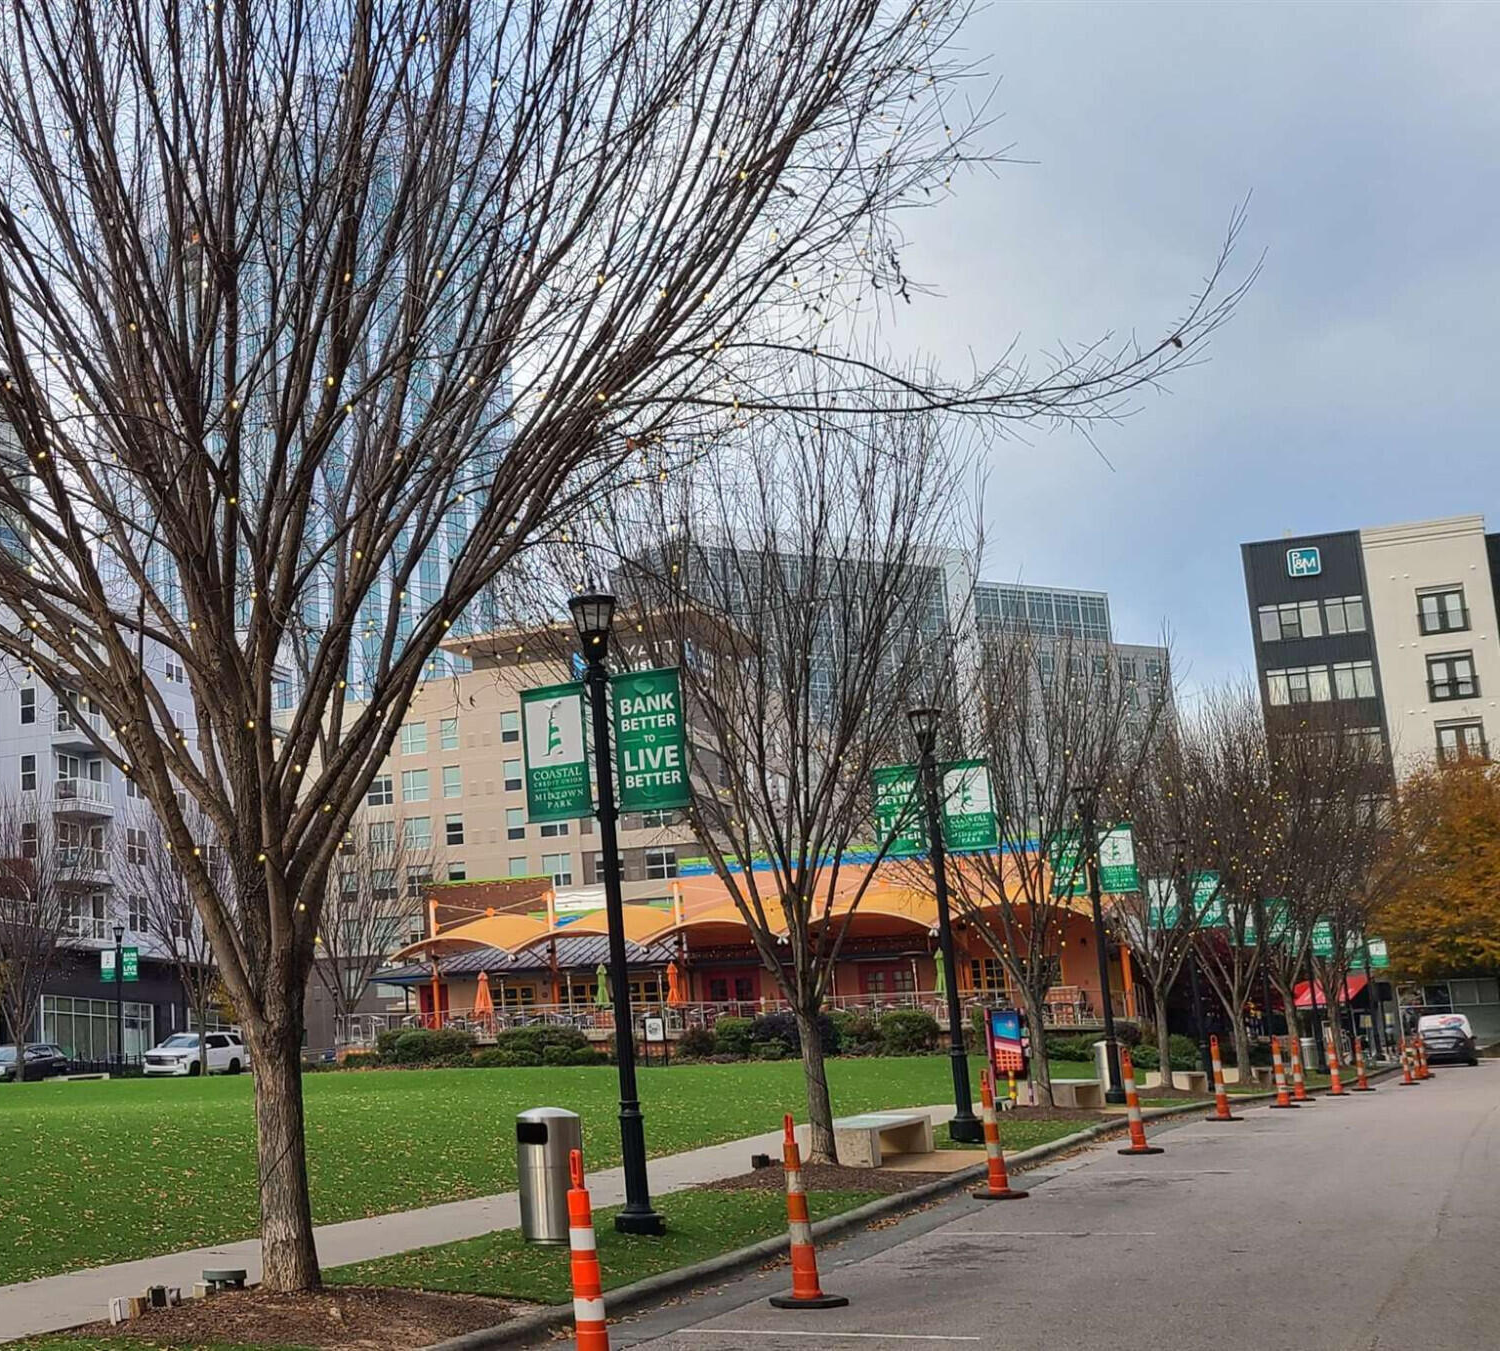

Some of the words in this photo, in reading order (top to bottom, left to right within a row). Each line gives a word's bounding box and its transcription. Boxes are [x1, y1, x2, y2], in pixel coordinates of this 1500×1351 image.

[620, 692, 675, 716] BANK
[621, 713, 677, 732] BETTER
[643, 734, 656, 743] TO
[624, 745, 680, 772] LIVE
[533, 766, 583, 781] COASTAL
[625, 770, 682, 789] BETTER
[534, 788, 584, 801] MIDTOWN
[547, 799, 573, 809] PARK
